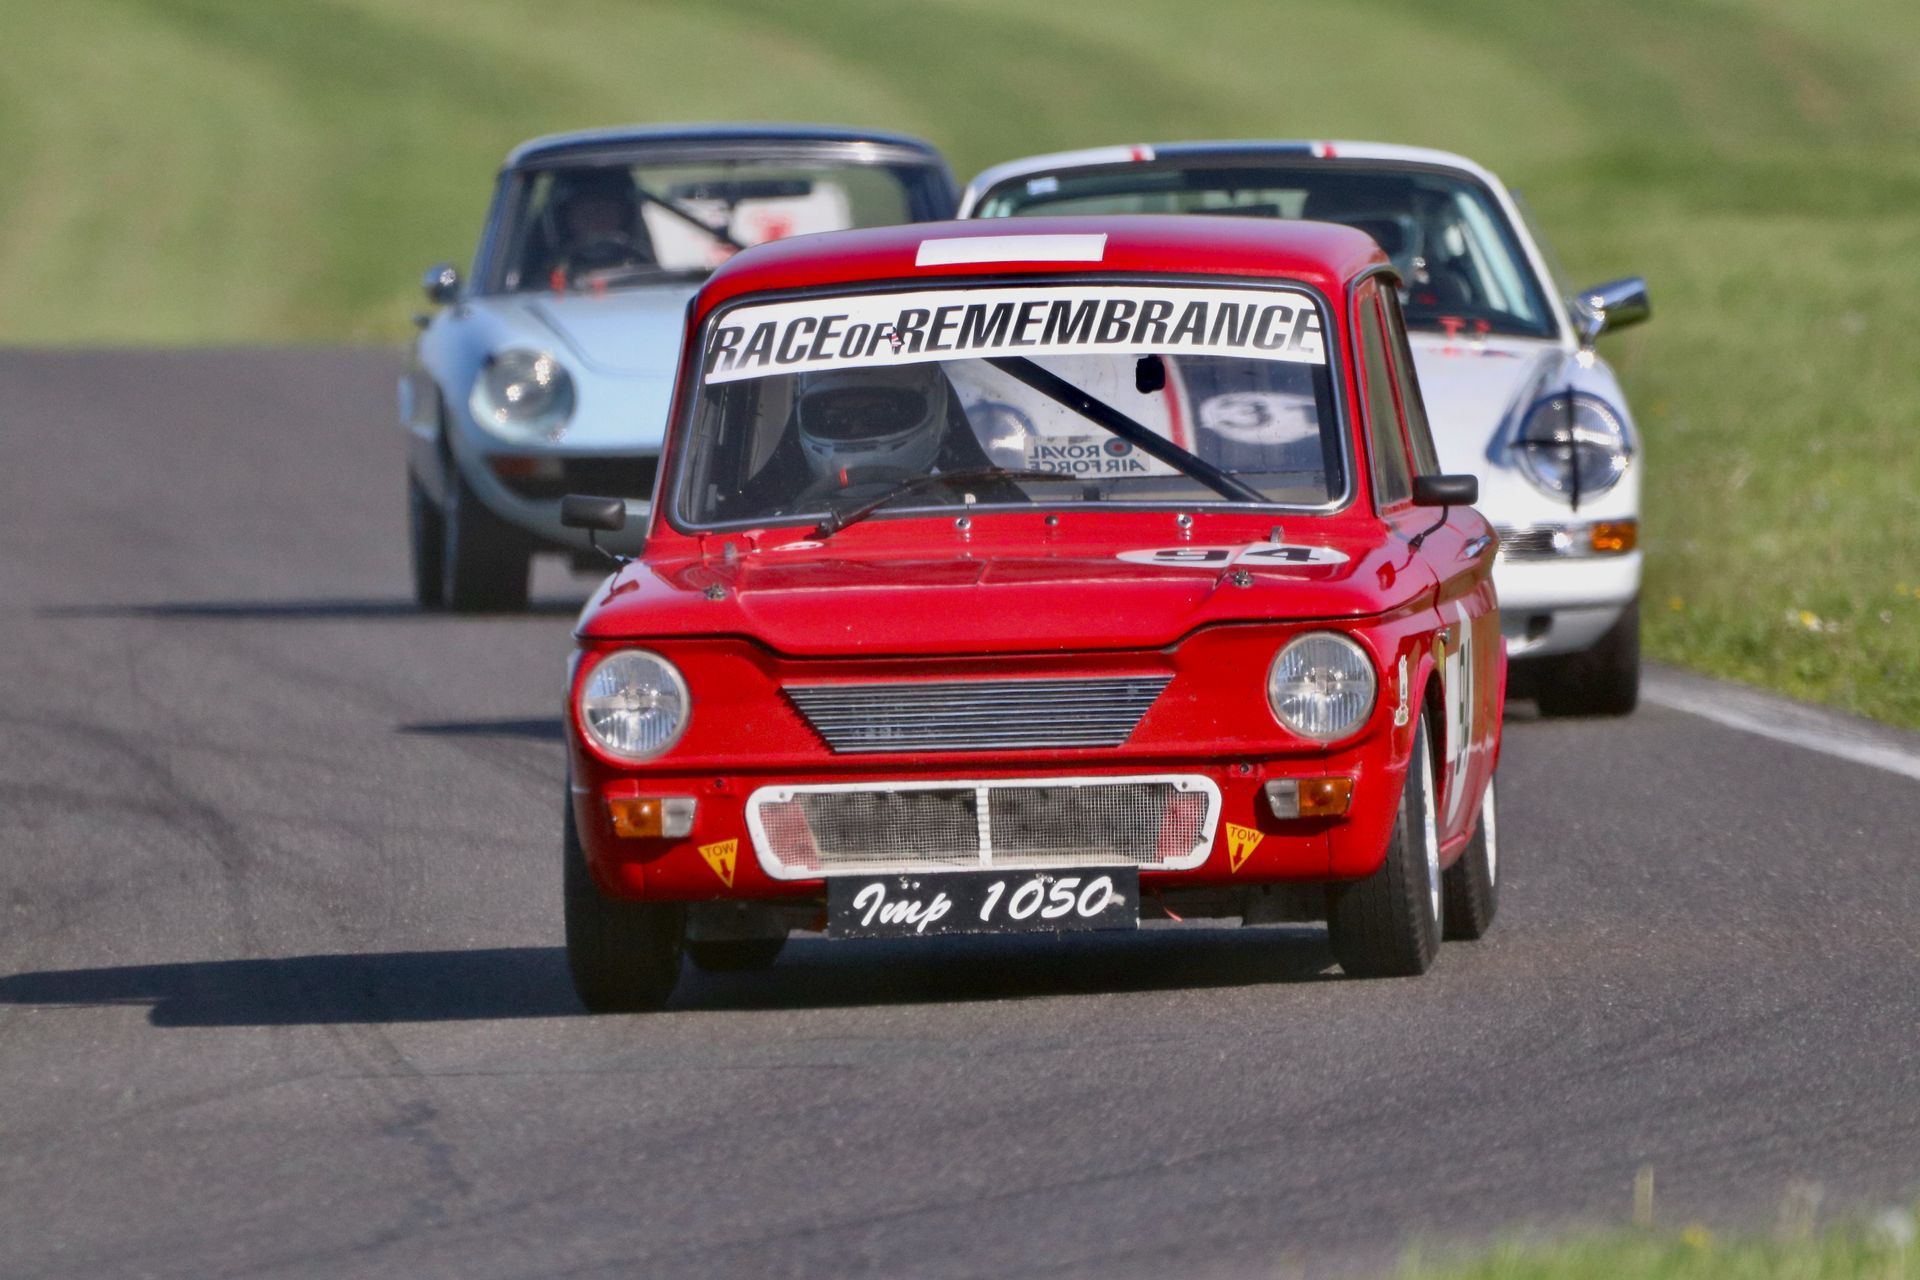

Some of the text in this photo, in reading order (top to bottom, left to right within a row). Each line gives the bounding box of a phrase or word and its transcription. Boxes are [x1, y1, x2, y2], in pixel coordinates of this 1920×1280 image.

[704, 299, 1320, 374] RACE OF REMEMBRANCE
[1152, 547, 1321, 563] 94
[1229, 825, 1261, 843] TOW
[703, 842, 735, 858] TOW
[852, 875, 1114, 933] Imp 1050
